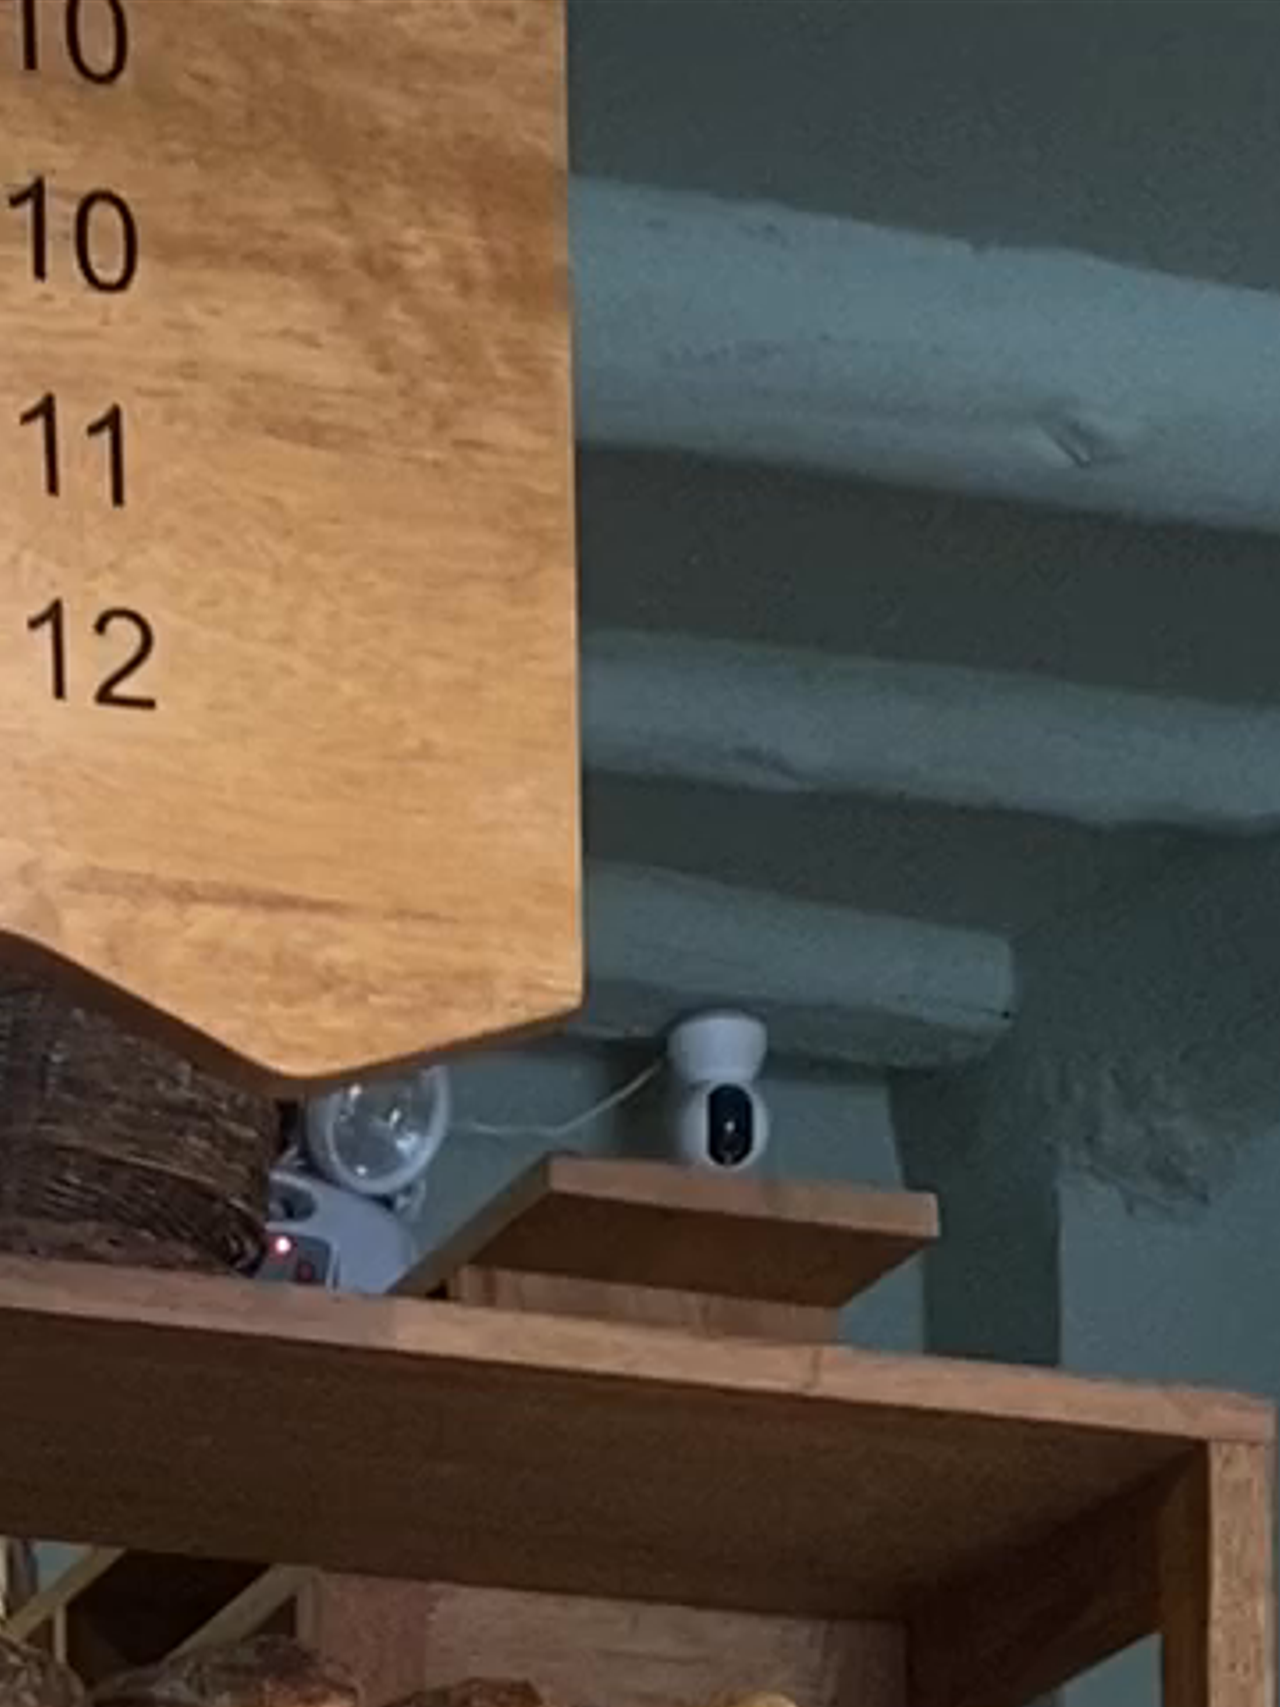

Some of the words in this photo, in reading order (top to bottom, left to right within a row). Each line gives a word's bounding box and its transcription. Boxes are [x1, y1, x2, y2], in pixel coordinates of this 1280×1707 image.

[16, 0, 130, 85] 10
[8, 174, 138, 292] 10
[19, 392, 126, 507] 11
[26, 597, 157, 711] 12
